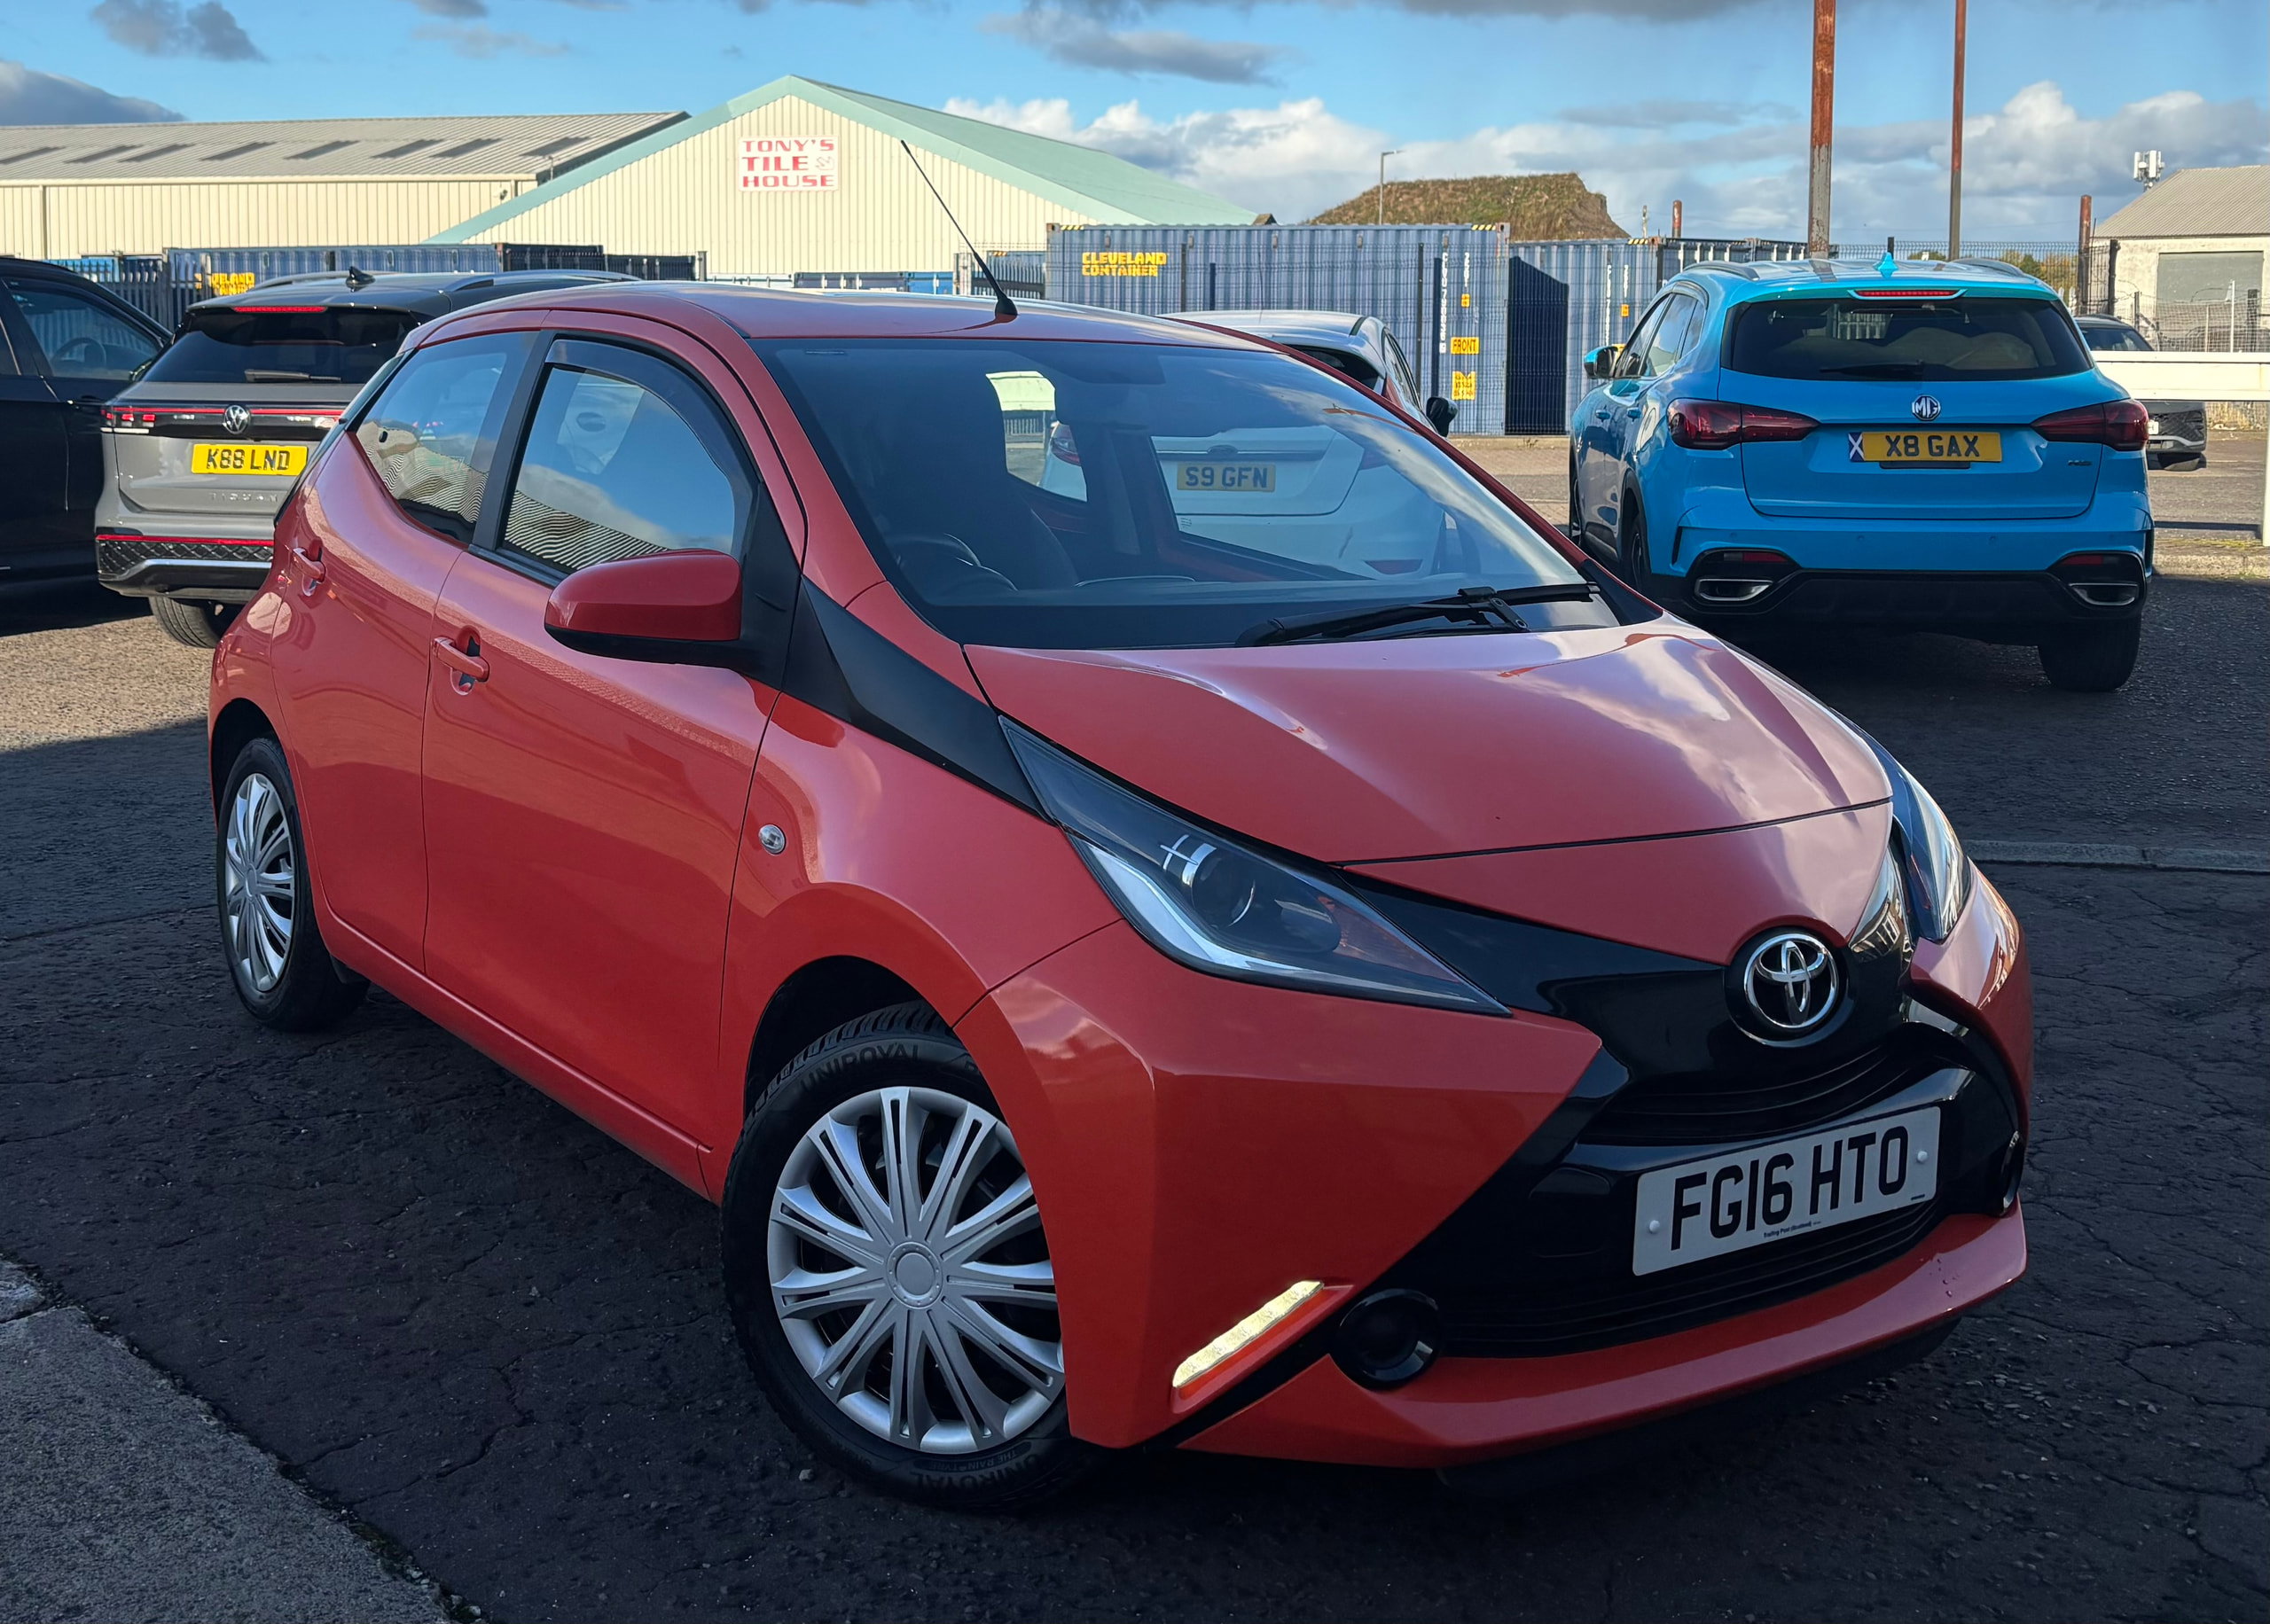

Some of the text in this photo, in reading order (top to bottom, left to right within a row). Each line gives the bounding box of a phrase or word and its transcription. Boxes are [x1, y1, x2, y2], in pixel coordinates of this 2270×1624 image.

[743, 139, 834, 152] TONY'S
[741, 156, 809, 171] TILE
[742, 175, 834, 187] HOUSE
[1082, 252, 1168, 265] CLEVELAND
[1452, 339, 1476, 352] FRONT
[1911, 395, 1941, 421] MG
[1885, 434, 1981, 457] X8 GAX
[207, 448, 291, 471] K88 LND
[1186, 466, 1268, 488] S9 GFN
[1671, 1125, 1909, 1251] FG16 HTO
